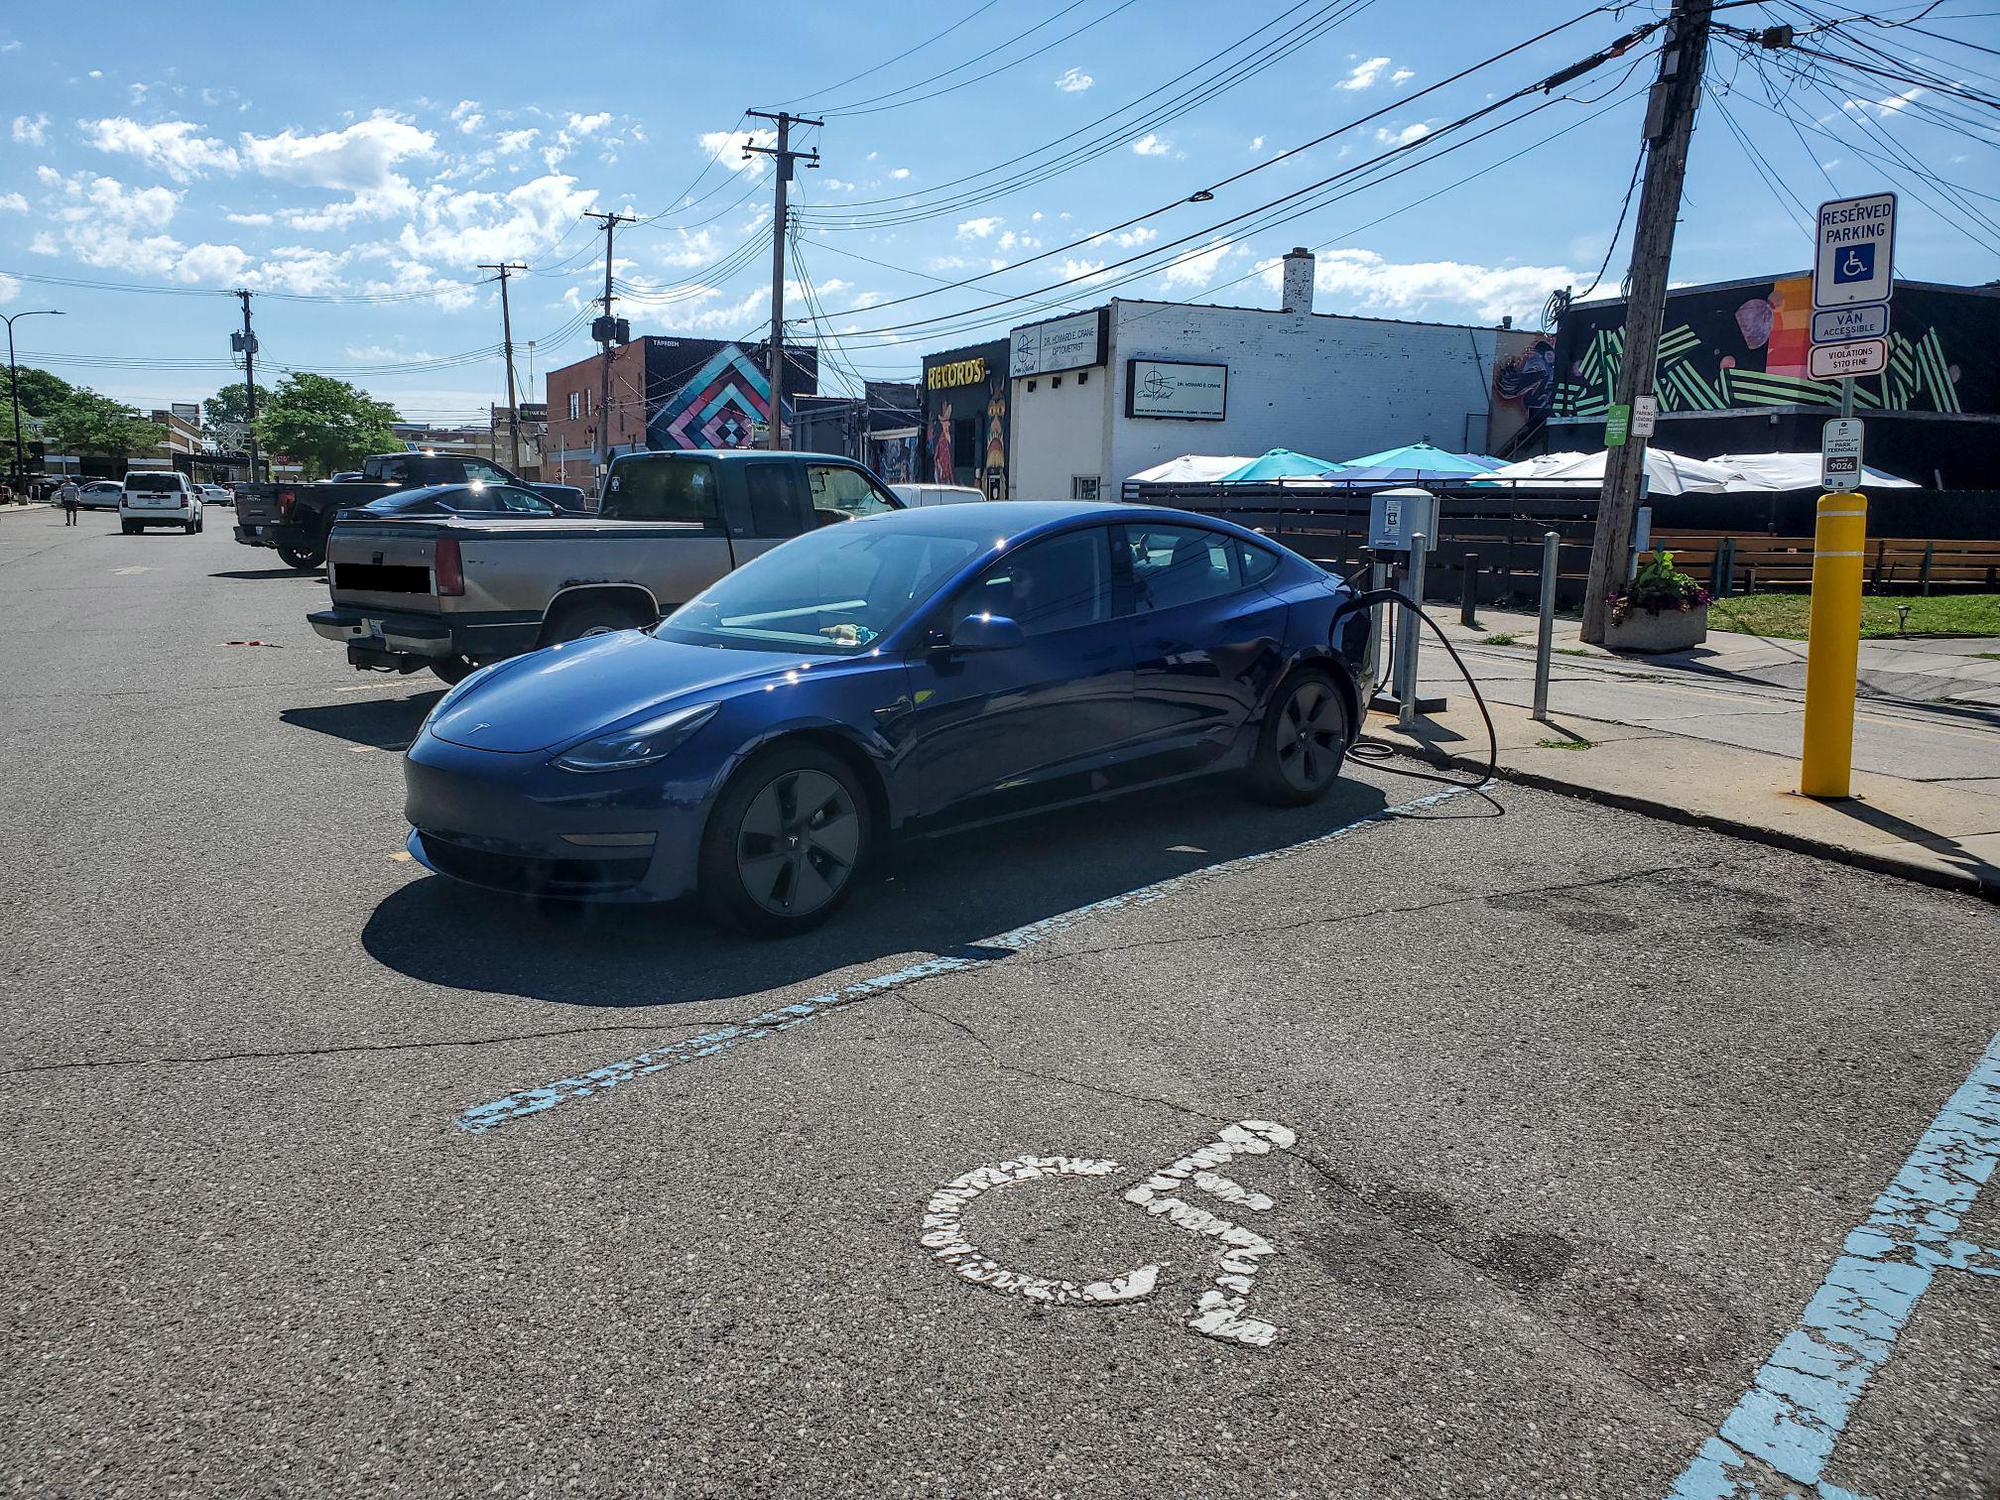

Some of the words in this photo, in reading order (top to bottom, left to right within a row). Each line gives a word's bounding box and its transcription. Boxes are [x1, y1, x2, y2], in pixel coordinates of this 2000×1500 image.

[1822, 203, 1891, 226] RESERVED
[1826, 222, 1885, 243] PARKING
[1836, 313, 1863, 325] VAN
[1823, 324, 1875, 336] ACCESSIBLE
[1829, 347, 1873, 360] VIOLATIONS
[1833, 360, 1850, 369] $170
[1852, 358, 1868, 367] FINE
[927, 357, 985, 390] RECORDS
[1831, 462, 1853, 470] 9026
